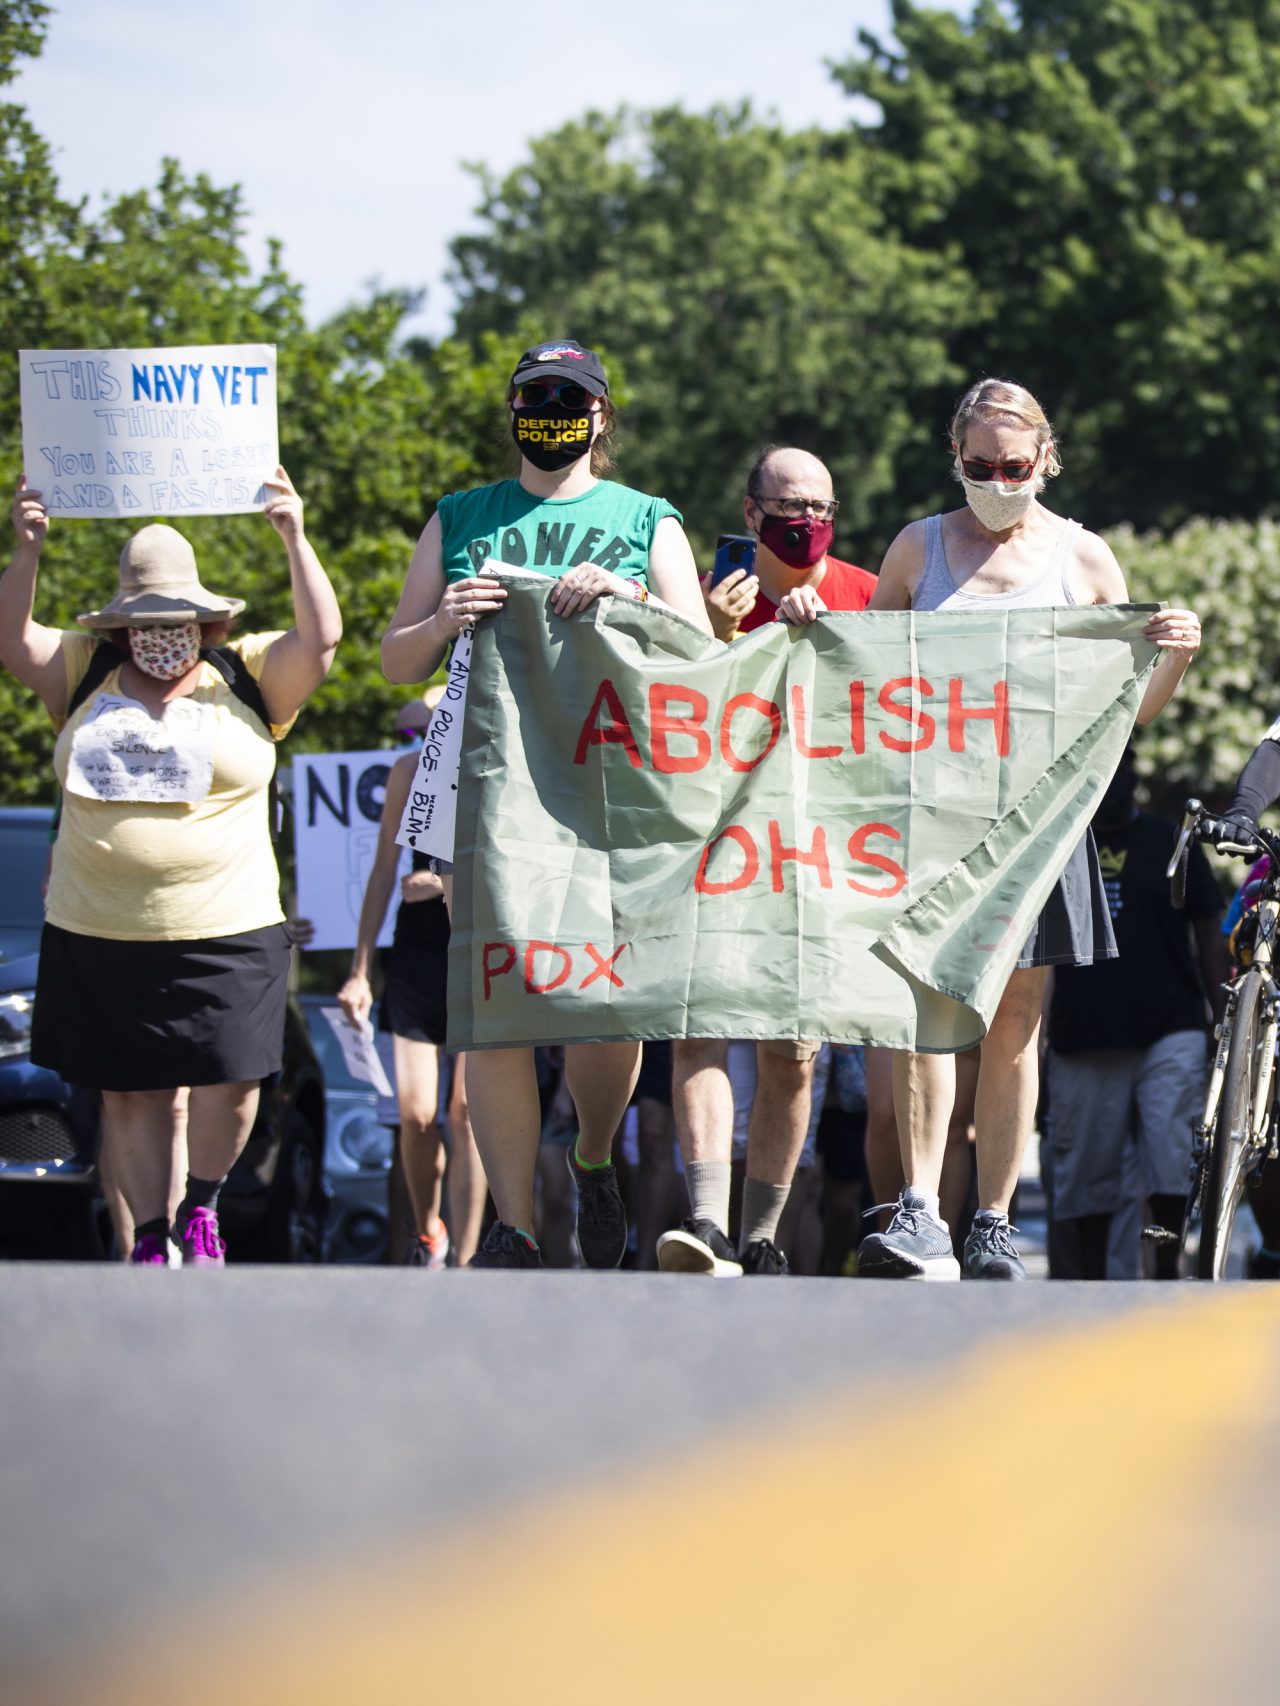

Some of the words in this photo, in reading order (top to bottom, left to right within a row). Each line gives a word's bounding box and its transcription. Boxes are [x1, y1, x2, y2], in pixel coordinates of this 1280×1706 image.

[30, 360, 122, 401] THIS
[131, 363, 203, 404] NAVY
[212, 365, 269, 407] VET
[94, 405, 223, 441] THINKS
[518, 418, 589, 430] DEFUND
[518, 429, 589, 443] POLICE
[40, 446, 96, 477] YOU
[106, 450, 156, 476] ARE
[170, 447, 190, 477] A
[202, 443, 272, 472] LOSER
[50, 483, 114, 509] AND
[122, 484, 142, 508] A
[466, 521, 632, 576] POWER
[445, 660, 470, 701] AND
[422, 708, 454, 772] POLICE
[573, 676, 1012, 775] ABOLISH
[111, 740, 168, 756] SILENCE
[129, 765, 145, 775] OF
[149, 765, 179, 777] MOMS
[129, 778, 141, 788] OF
[405, 790, 430, 834] BLM
[424, 794, 438, 831] because
[694, 819, 908, 898] OHS
[482, 941, 626, 1001] PDX
